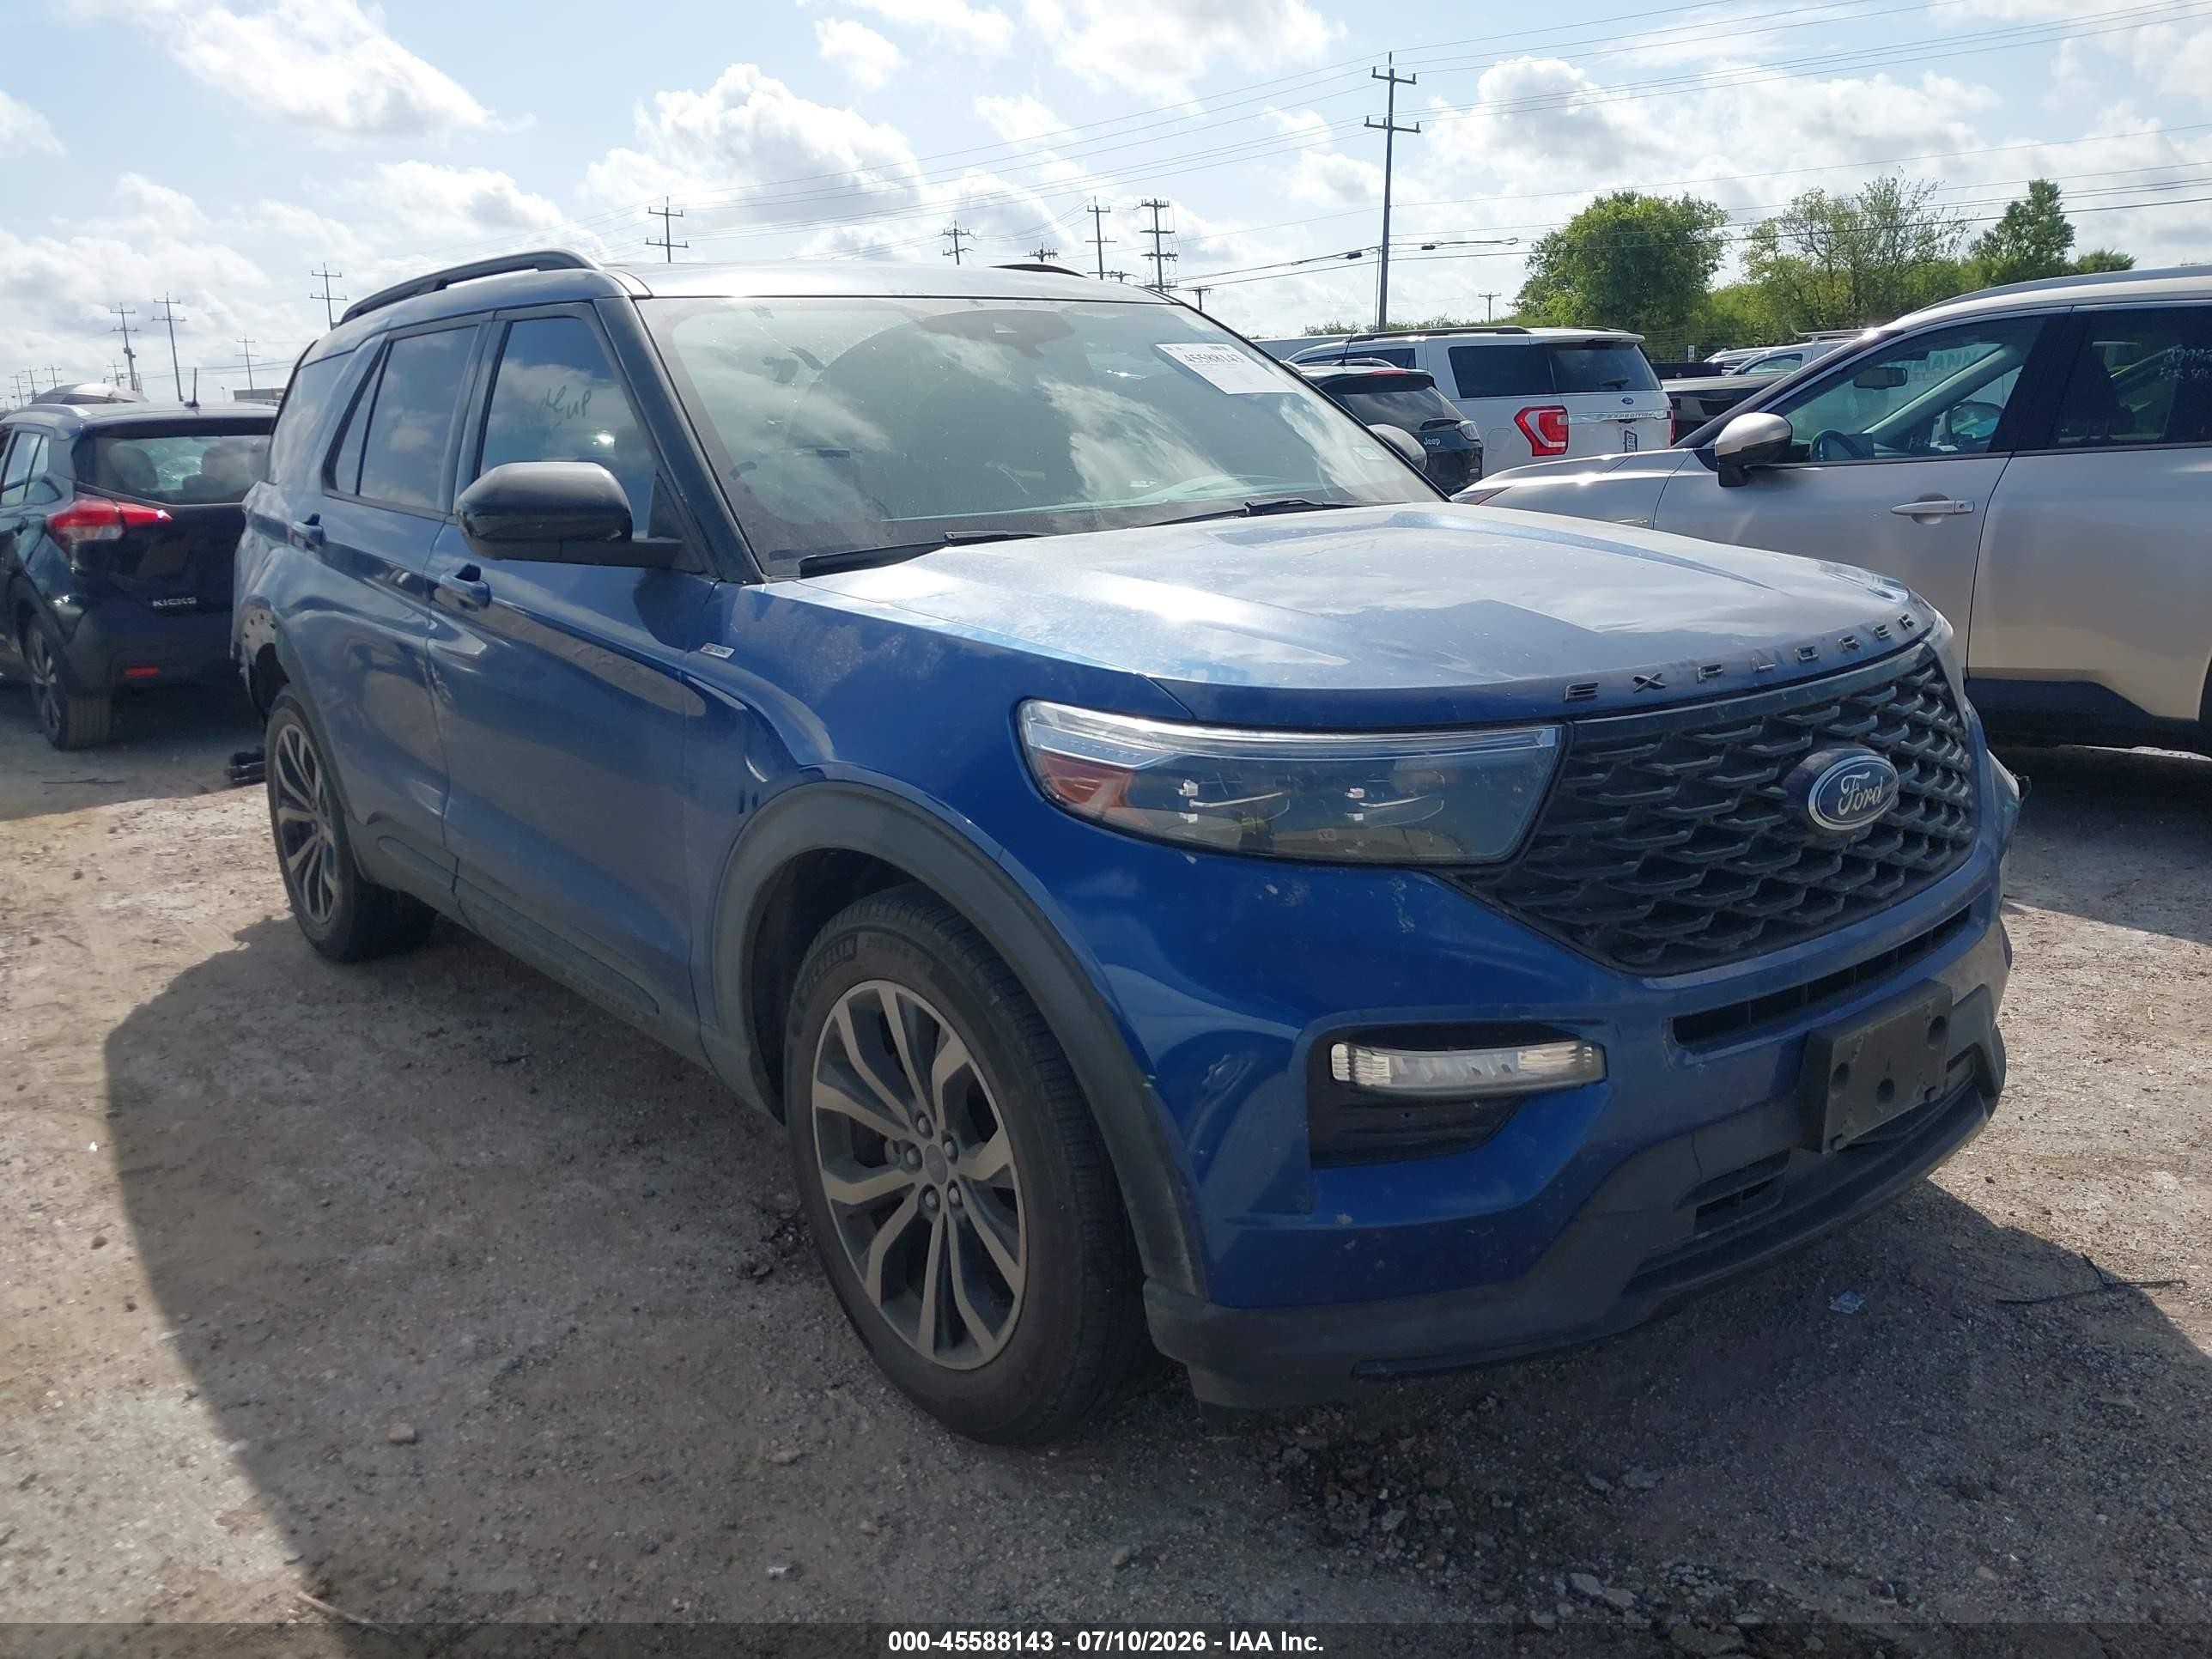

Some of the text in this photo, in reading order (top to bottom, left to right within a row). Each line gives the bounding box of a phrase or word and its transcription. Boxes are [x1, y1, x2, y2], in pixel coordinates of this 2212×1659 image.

[1423, 436, 1441, 447] Jeep
[152, 597, 198, 606] KICKS
[1564, 611, 1915, 702] EXPLORER
[1838, 770, 1884, 817] Ford
